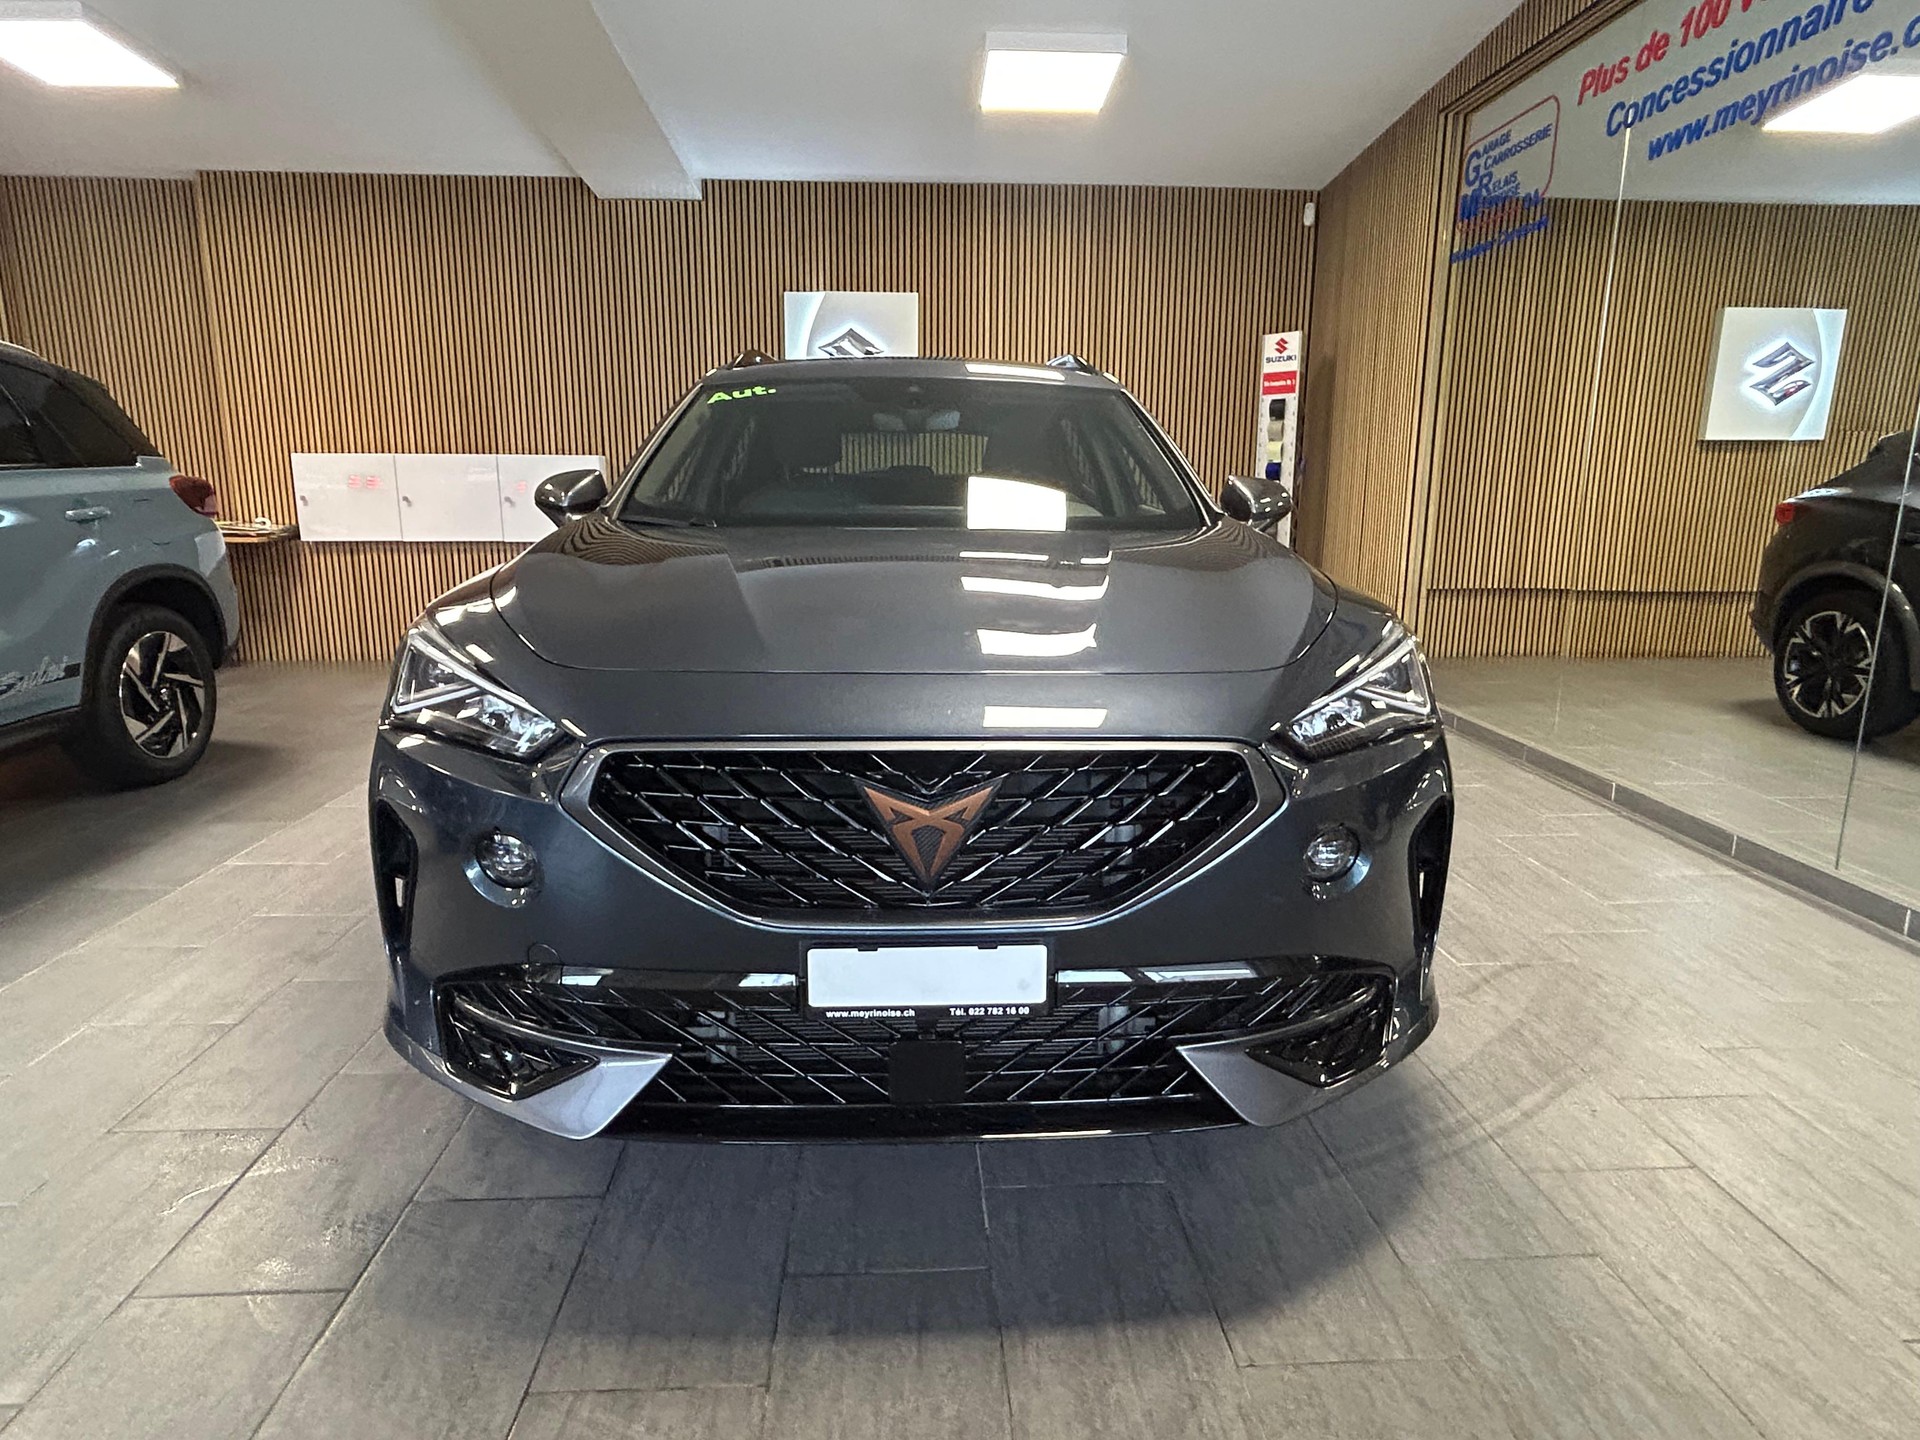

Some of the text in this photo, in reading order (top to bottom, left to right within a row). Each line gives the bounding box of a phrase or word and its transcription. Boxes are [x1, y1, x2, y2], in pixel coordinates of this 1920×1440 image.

[1577, 0, 1732, 107] Plus de 100
[1484, 122, 1553, 171] CARROSSERIE
[1265, 354, 1297, 364] SUZUKI
[707, 385, 777, 404] Aut.
[825, 1008, 916, 1019] www.meyrinoise.ch
[968, 1007, 985, 1016] 022
[987, 1006, 1004, 1015] 782
[1018, 1006, 1030, 1015] 00
